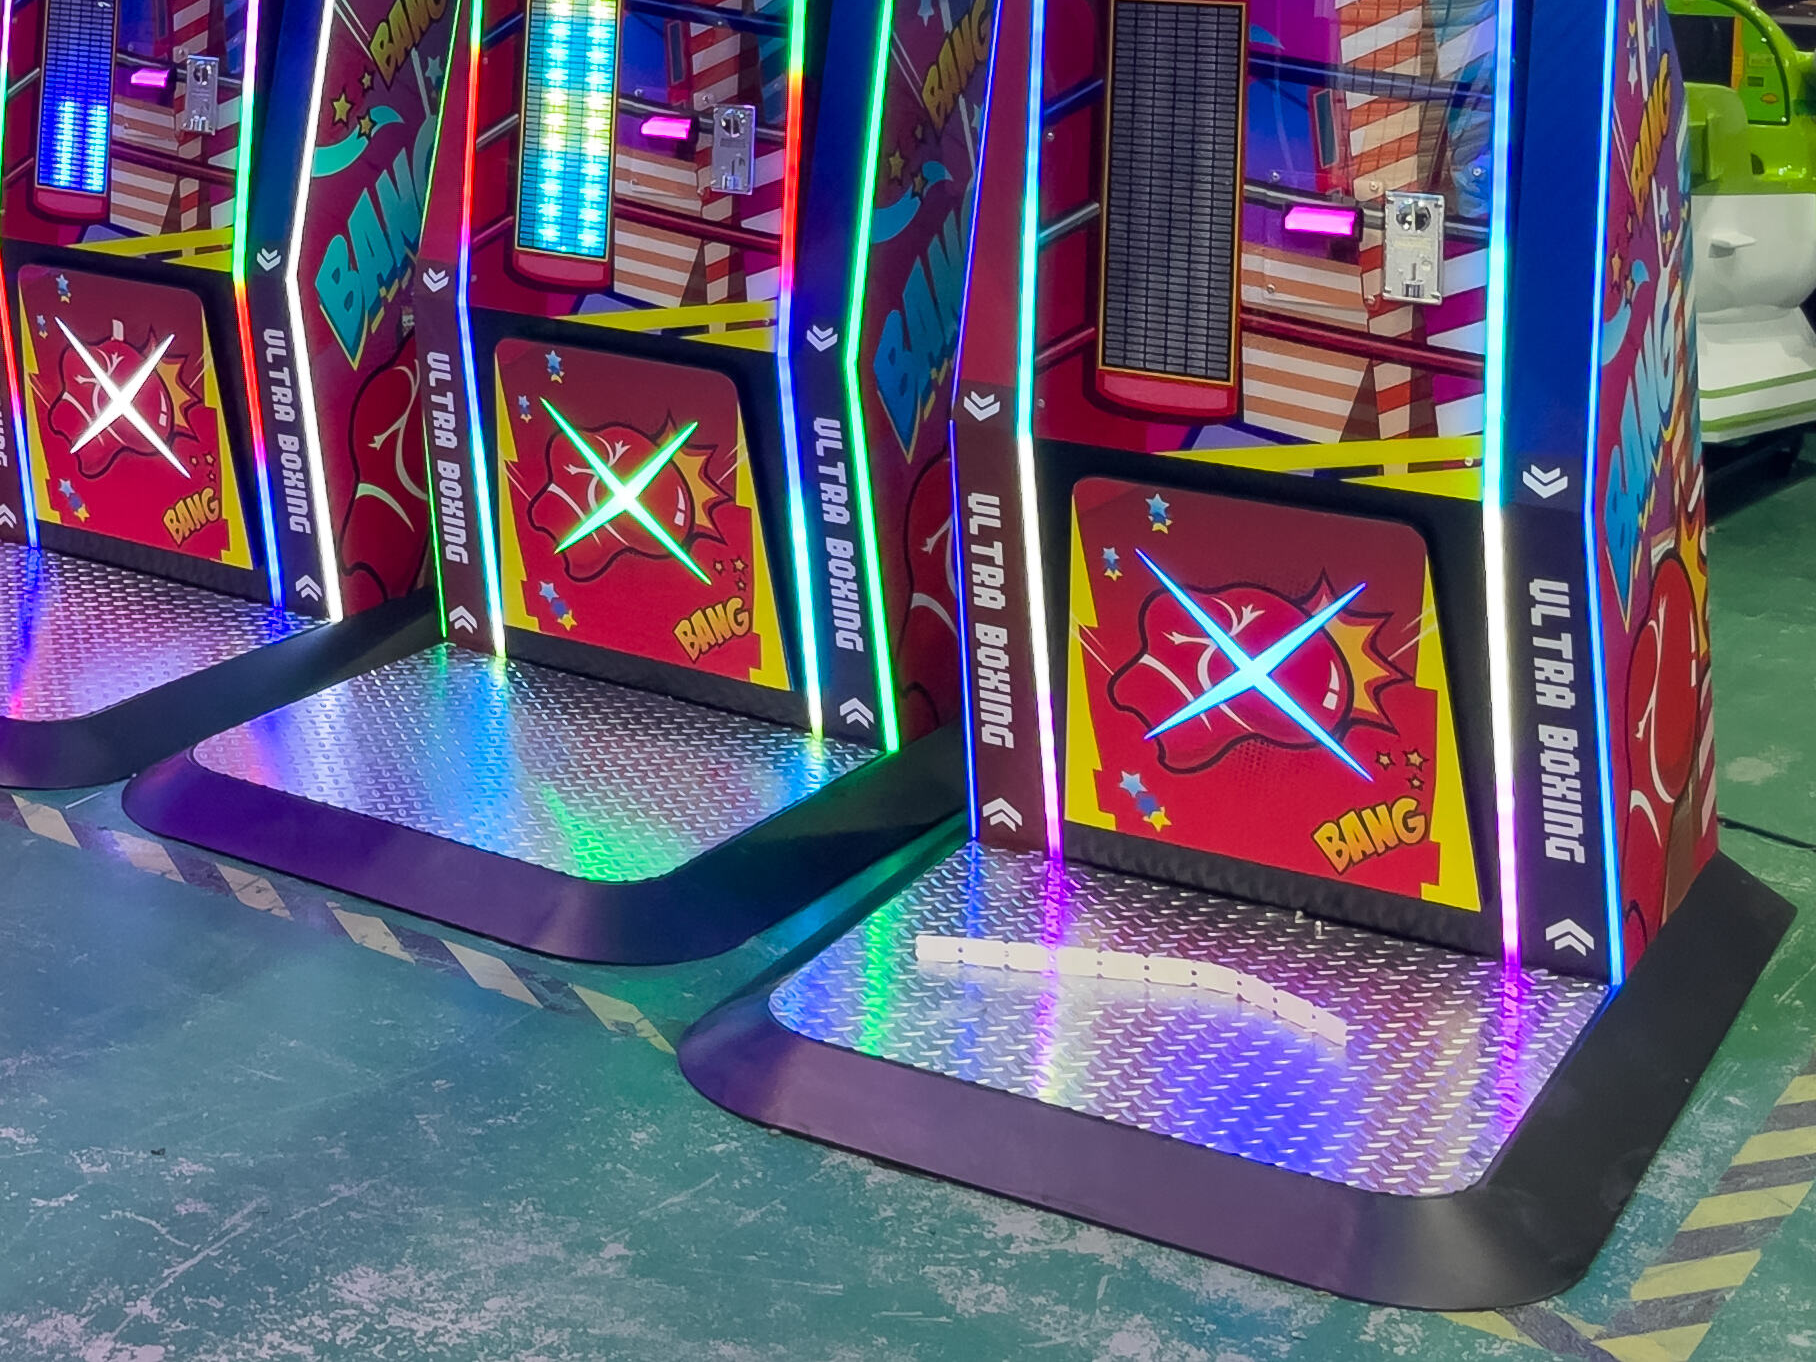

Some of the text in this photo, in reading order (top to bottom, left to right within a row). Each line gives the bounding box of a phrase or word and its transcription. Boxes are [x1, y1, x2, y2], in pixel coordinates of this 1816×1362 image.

[162, 486, 222, 548] BANG
[264, 328, 311, 535] ULTRA BOXING
[427, 351, 469, 565] ULTRA BOXING
[813, 417, 864, 653] ULTRA BOXING
[672, 596, 751, 663] BANG
[968, 493, 1014, 750] ULTRA BOXING
[1529, 578, 1585, 865] ULTRA BOXING
[1312, 798, 1429, 875] BANG
